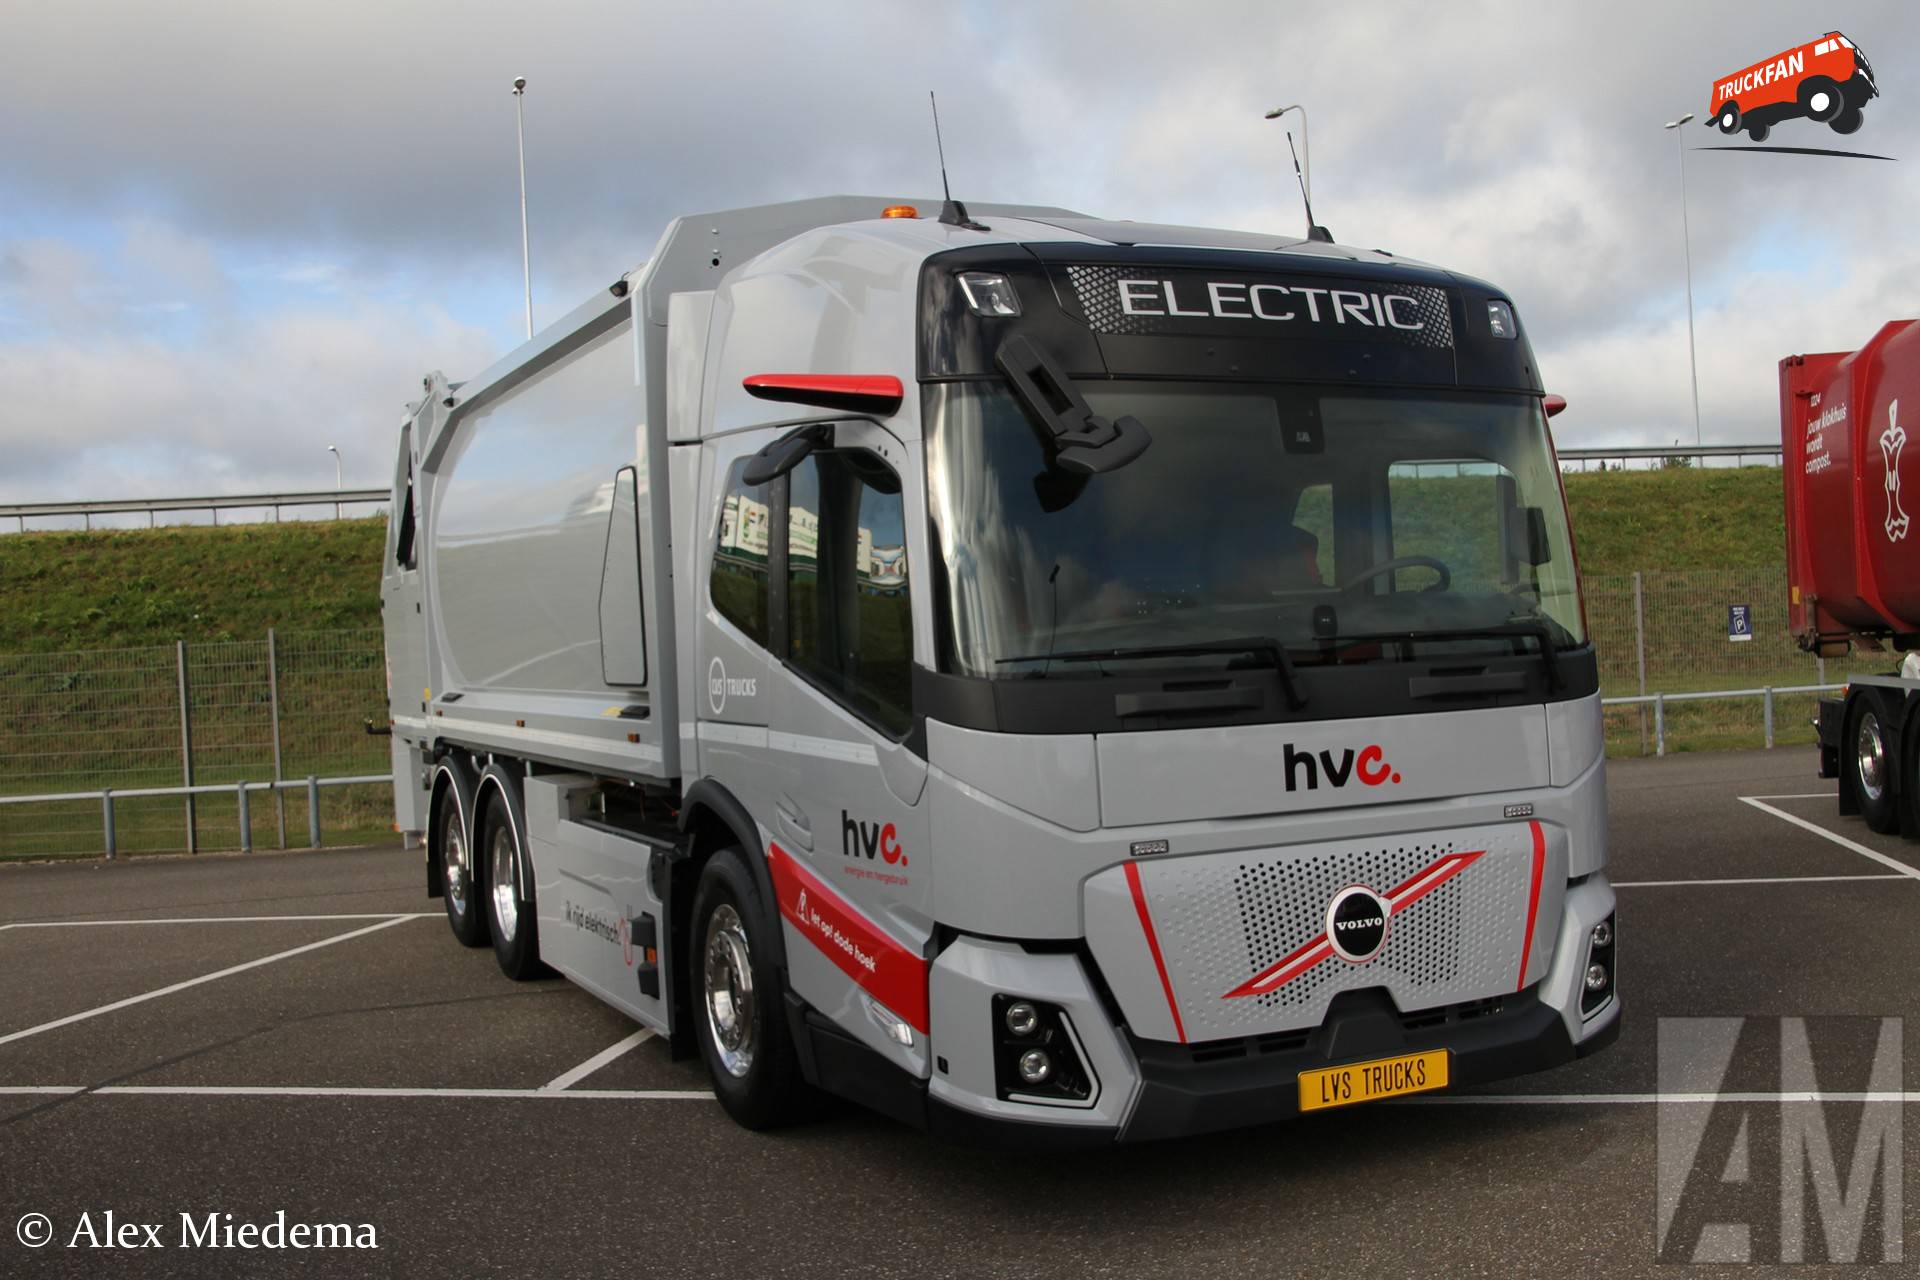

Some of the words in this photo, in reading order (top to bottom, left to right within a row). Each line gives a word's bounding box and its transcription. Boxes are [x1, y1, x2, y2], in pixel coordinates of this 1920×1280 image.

[1117, 279, 1424, 330] ELECTRIC
[1806, 419, 1821, 440] jouw
[1821, 403, 1847, 429] klokhuis
[727, 678, 757, 696] TRUCKS
[1336, 917, 1383, 931] VOLVO
[834, 930, 853, 955] dode
[855, 945, 875, 973] hoek
[1321, 1071, 1351, 1103] LVS
[1362, 1058, 1426, 1095] TRUCKS
